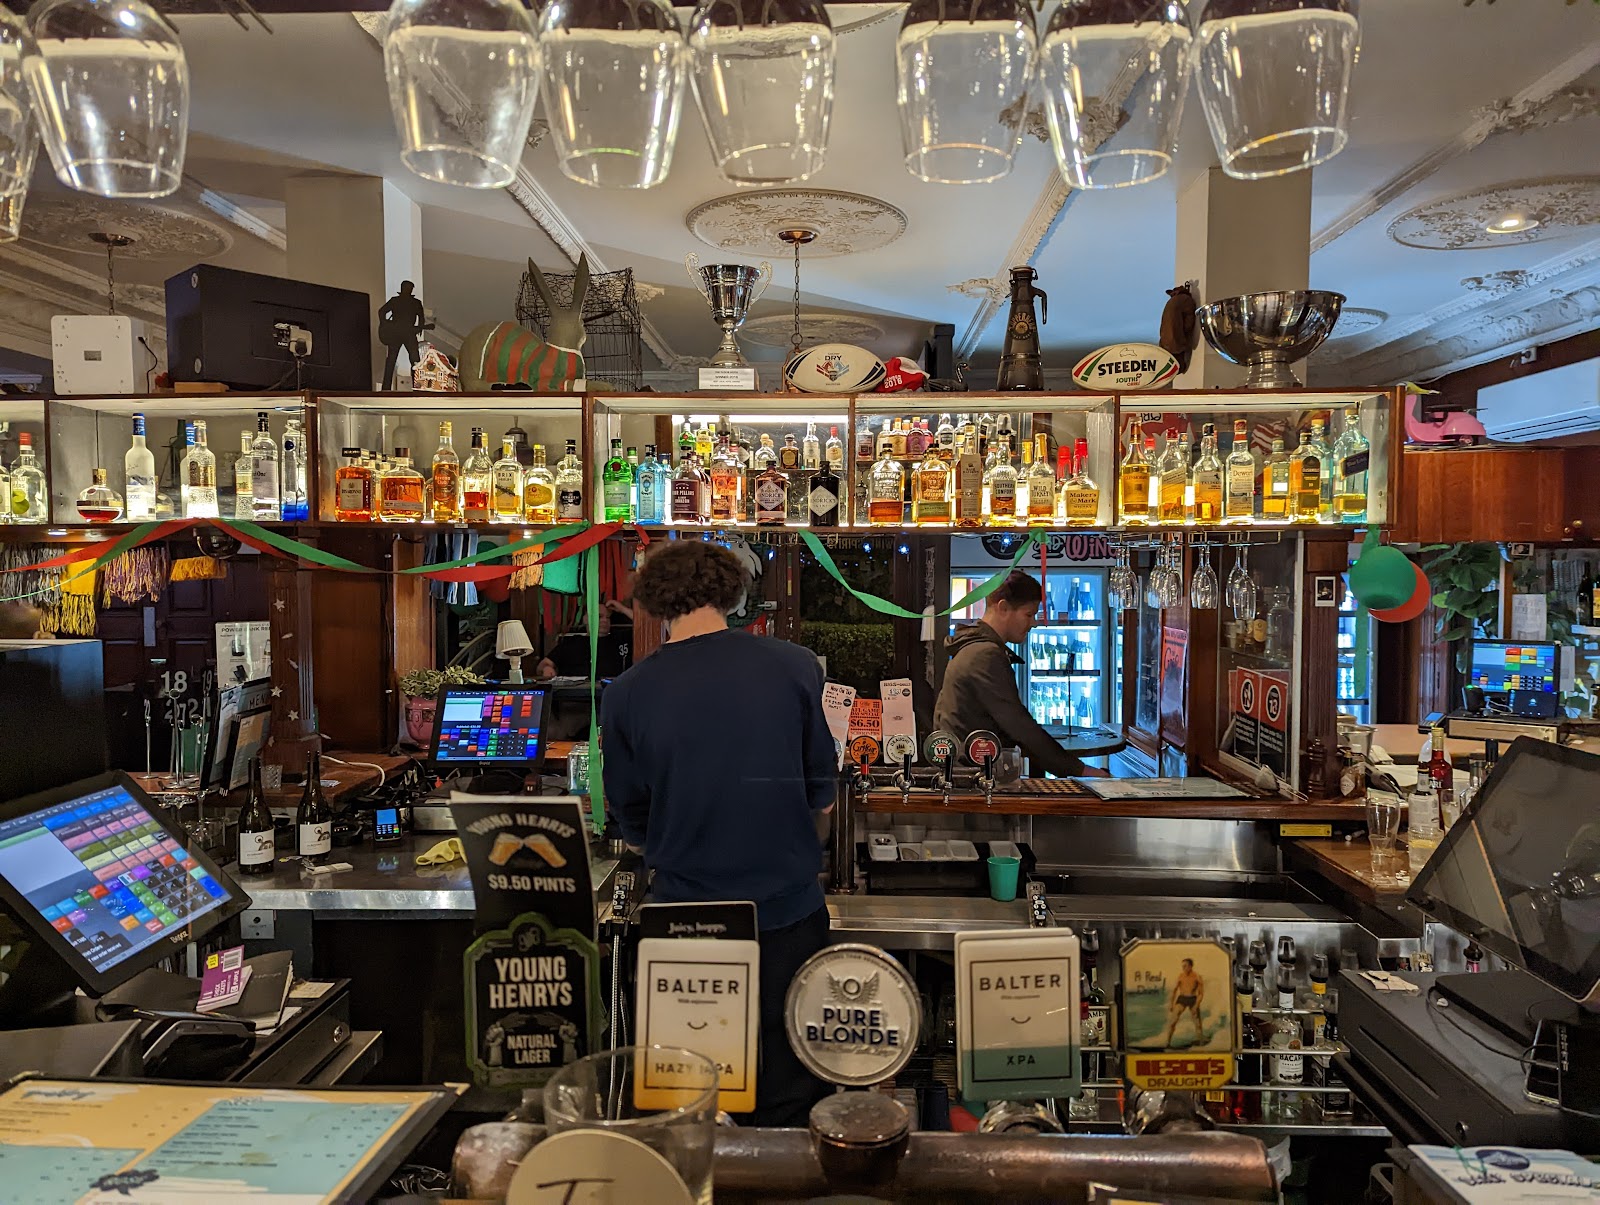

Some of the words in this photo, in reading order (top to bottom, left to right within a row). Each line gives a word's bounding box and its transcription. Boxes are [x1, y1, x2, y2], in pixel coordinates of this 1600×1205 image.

[1097, 359, 1158, 377] STEEDEN
[618, 643, 629, 656] 35
[160, 670, 188, 693] 18
[850, 719, 879, 728] $6.50
[465, 813, 513, 836] YOUNG
[515, 813, 576, 839] HENRYS
[487, 873, 531, 891] $9.50
[533, 876, 576, 893] PINTS
[494, 956, 567, 983] YOUNG
[656, 977, 740, 995] BALTER
[978, 973, 1062, 991] BALTER
[489, 981, 573, 1009] HENRYS
[822, 1005, 881, 1027] PURE
[506, 1033, 558, 1050] NATURAL
[806, 1024, 899, 1046] BLONDE
[514, 1049, 551, 1064] LAGER
[1006, 1054, 1036, 1066] XPA
[655, 1062, 693, 1075] HAZY
[1146, 1076, 1214, 1088] DRAUGHT
